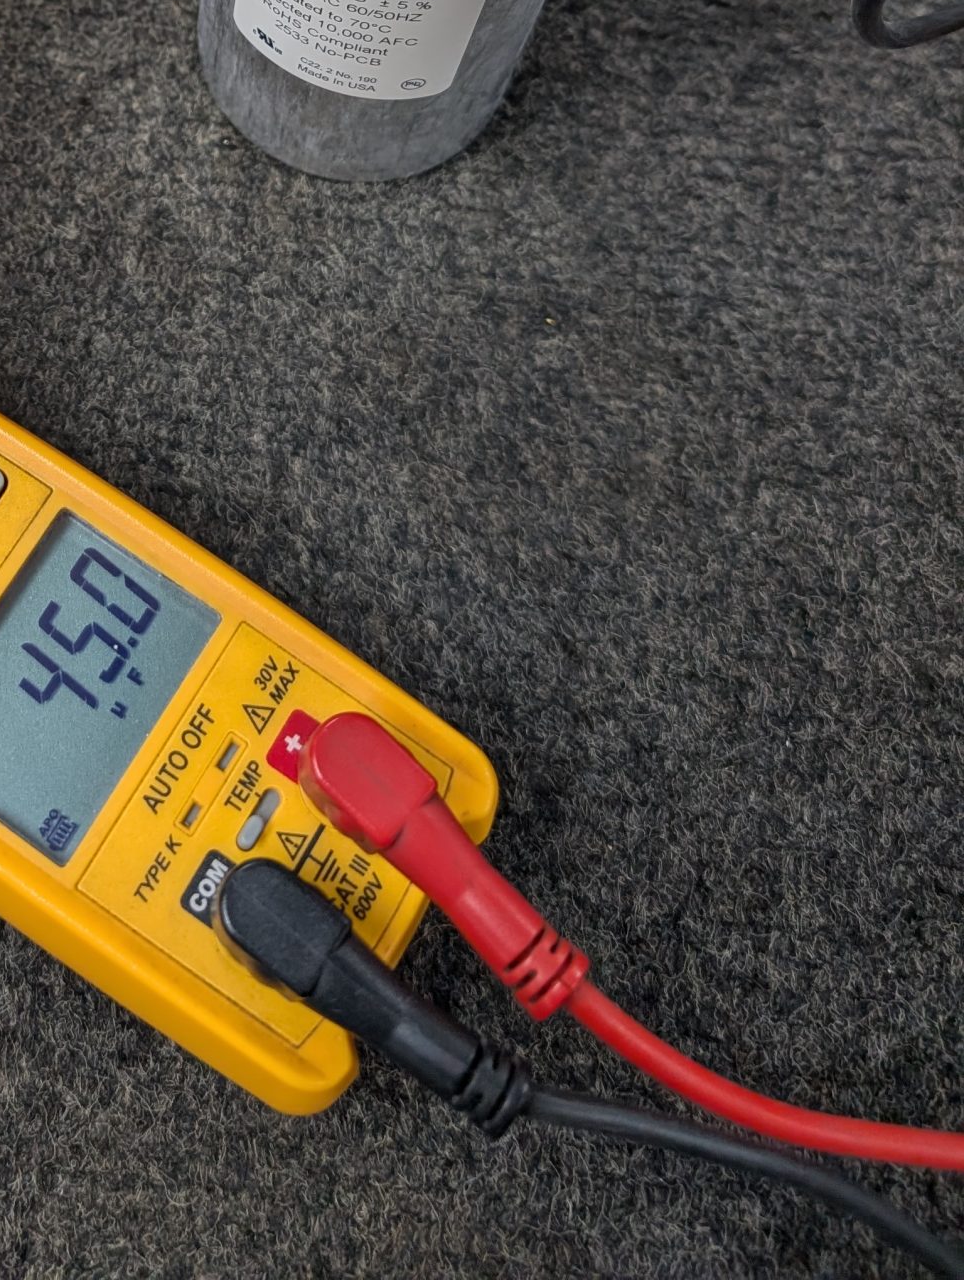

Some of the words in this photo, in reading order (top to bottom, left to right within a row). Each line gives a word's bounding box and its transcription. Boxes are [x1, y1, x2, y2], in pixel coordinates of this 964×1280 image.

[328, 11, 343, 23] to
[346, 4, 423, 22] 60/50HZ
[397, 1, 408, 10] 5
[416, 1, 432, 10] %
[274, 19, 310, 45] 2533
[315, 42, 382, 67] No-PCB
[307, 28, 389, 57] Compliant
[379, 37, 419, 47] AFC
[297, 64, 330, 82] Made
[348, 80, 376, 92] USA
[254, 655, 280, 692] 30V
[269, 661, 301, 706] MAX
[143, 749, 190, 815] AUTO
[181, 703, 216, 750] OFF
[224, 760, 262, 813] TEMP
[134, 852, 171, 903] TYPE
[165, 834, 182, 855] K
[189, 858, 229, 912] COM
[352, 872, 382, 921] 600V
